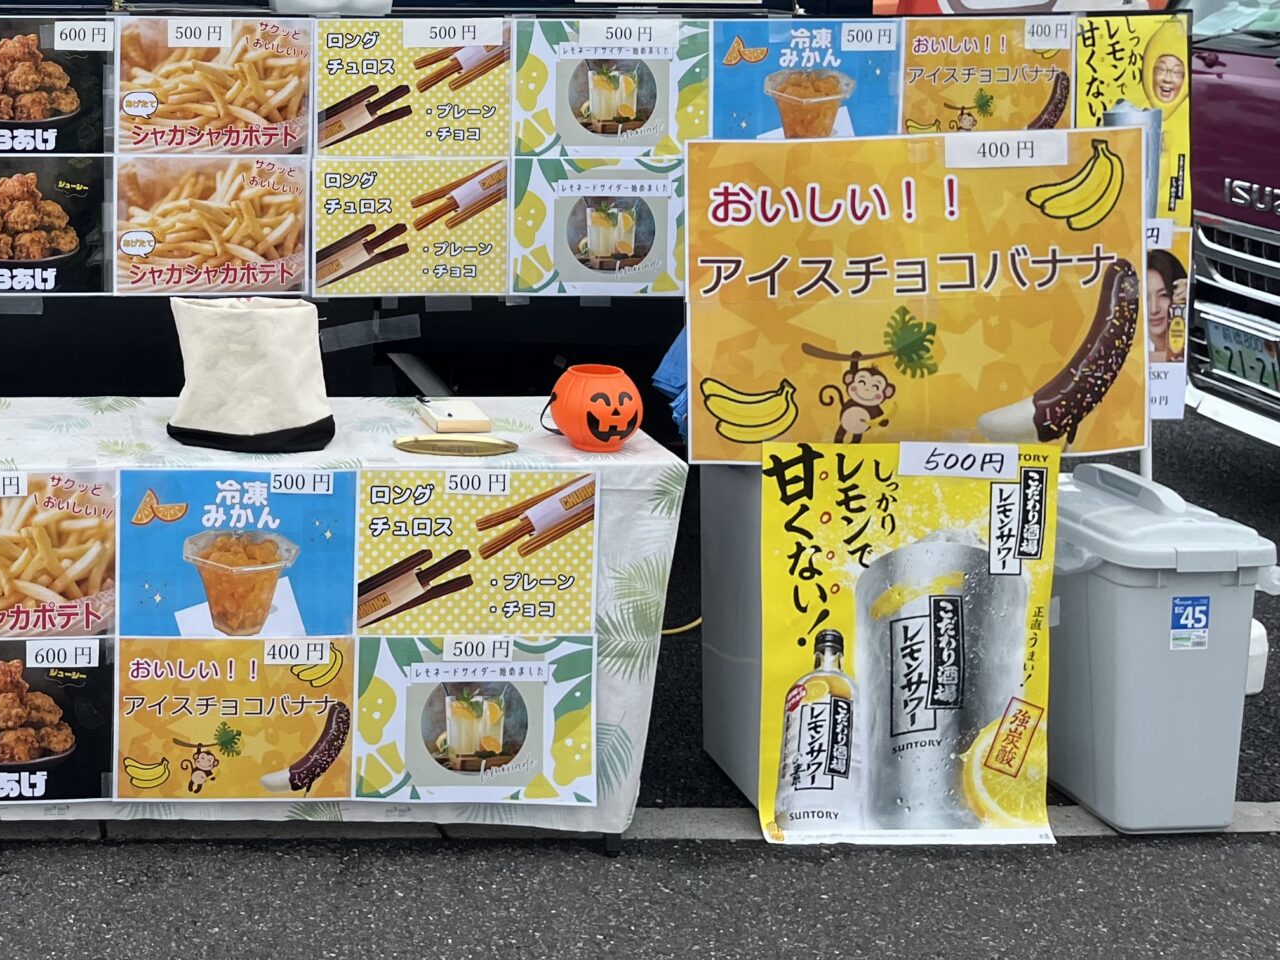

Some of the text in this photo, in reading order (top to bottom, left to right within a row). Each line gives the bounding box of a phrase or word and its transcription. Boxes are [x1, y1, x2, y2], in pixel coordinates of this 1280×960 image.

[259, 21, 302, 40] サクッと
[326, 31, 379, 50] ロング
[790, 28, 831, 48] 冷凍
[779, 49, 841, 68] みかん
[1105, 19, 1128, 95] レモンで
[1125, 16, 1143, 86] しっかり
[326, 59, 396, 75] チュロス
[908, 66, 1061, 84] アイスチョコバナナ
[132, 124, 297, 148] シャカシャカポテト
[255, 159, 297, 177] サクッと
[325, 171, 377, 189] ロング
[324, 198, 392, 214] チュロス
[129, 262, 295, 285] シャカシャカポテト
[699, 246, 1118, 299] アイスチョコバナナ
[924, 448, 1005, 473] 500円
[49, 474, 104, 497] サクッと
[216, 480, 269, 505] 冷凍
[370, 482, 434, 505] ロング
[874, 459, 899, 536] しっかり
[202, 505, 281, 529] みかん
[835, 452, 873, 569] レモンで
[1020, 472, 1042, 554] こだわり酒場
[370, 516, 453, 537] チュロス
[996, 488, 1016, 570] レモンサワー
[1180, 606, 1207, 628] 45
[49, 668, 87, 680] ジューシー
[900, 622, 928, 727] レモンサワー
[124, 693, 337, 718] アイスチョコバナナ
[806, 707, 826, 786] レモンサワー
[891, 738, 942, 754] SUNTORY
[995, 707, 1031, 769] 強炭酸
[789, 810, 839, 821] SUNTORY
